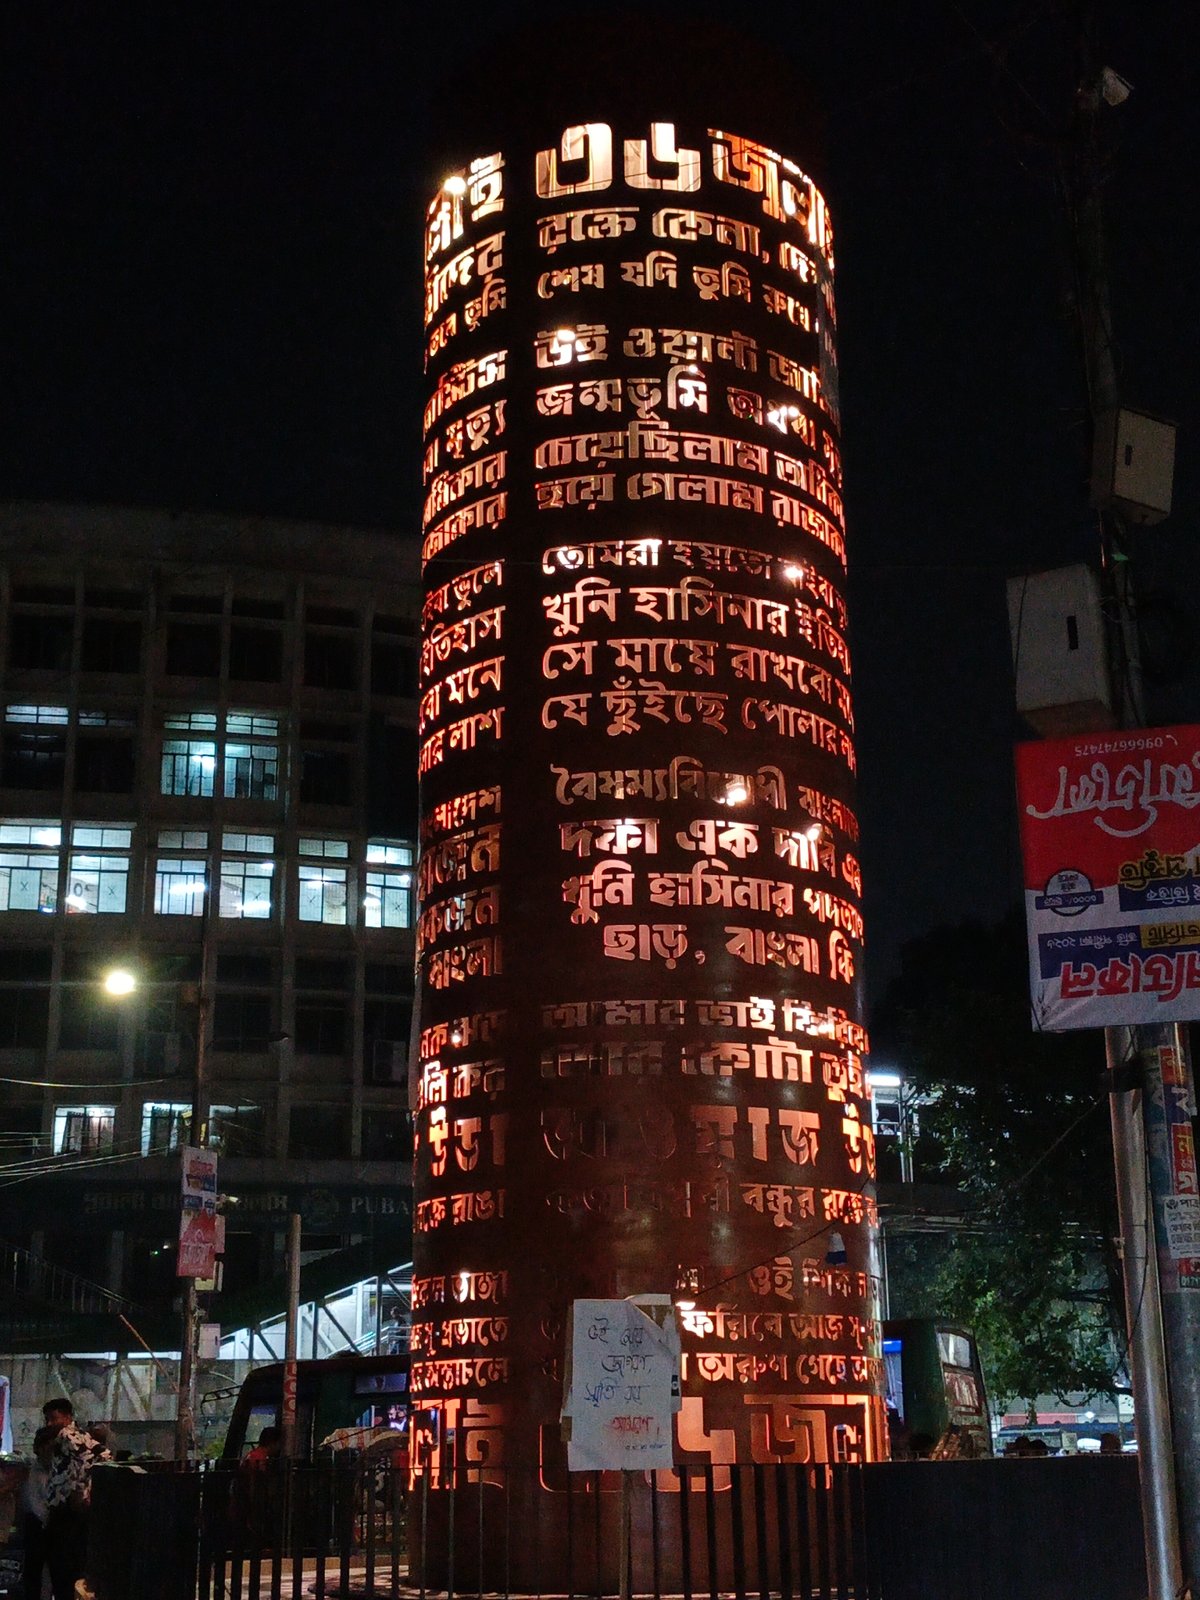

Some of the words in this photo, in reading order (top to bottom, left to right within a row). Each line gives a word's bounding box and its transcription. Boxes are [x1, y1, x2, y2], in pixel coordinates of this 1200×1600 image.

[535, 122, 701, 199] ৩৬
[536, 206, 640, 255] রক্তে
[537, 263, 605, 299] শেষ
[620, 251, 679, 289] যদি
[692, 260, 751, 303] তুমি
[534, 323, 609, 369] উই
[626, 472, 764, 514] গেলাম
[542, 538, 663, 576] তোমরা
[542, 576, 621, 636] খুনি
[629, 575, 789, 638] হাসিনার
[542, 640, 598, 680] সে
[542, 692, 594, 729] যে
[559, 818, 660, 858] দফা
[675, 819, 760, 859] এক
[562, 859, 635, 925] খুনি
[648, 858, 794, 917] হাসিনার
[724, 926, 819, 976] বাংলা
[351, 1195, 410, 1216] PUBA
